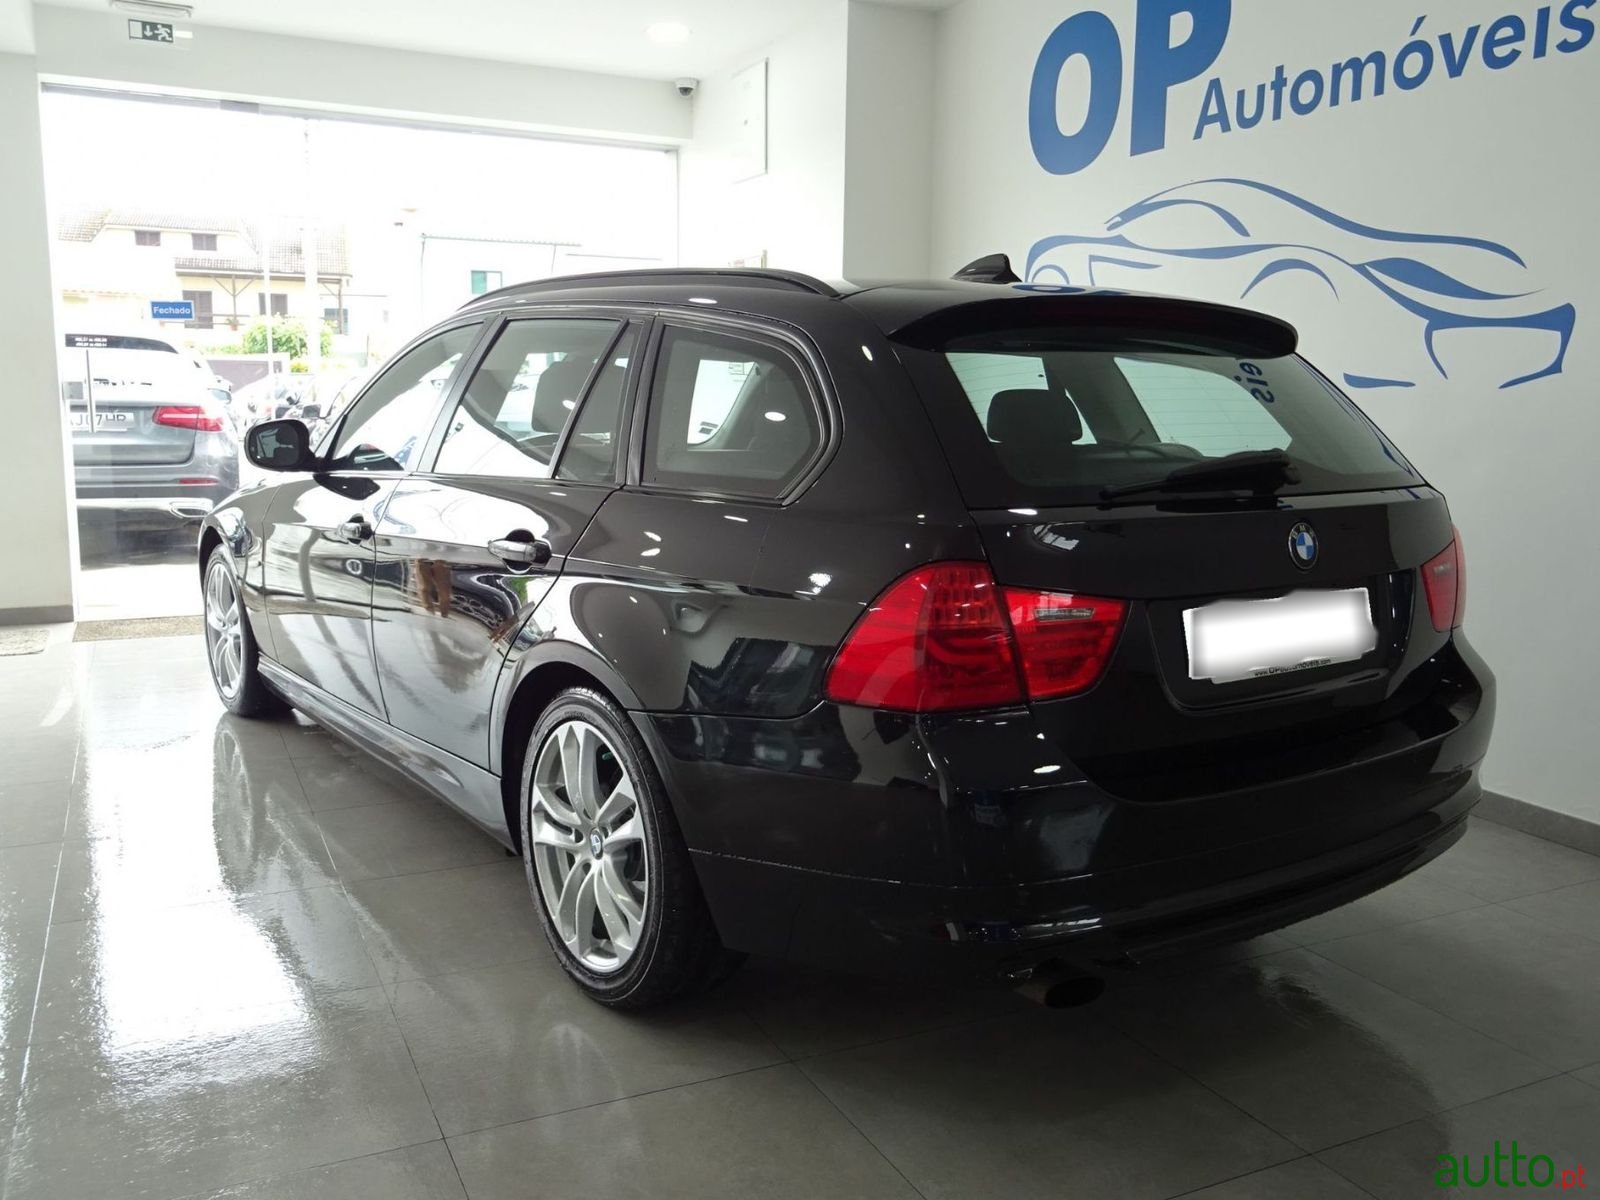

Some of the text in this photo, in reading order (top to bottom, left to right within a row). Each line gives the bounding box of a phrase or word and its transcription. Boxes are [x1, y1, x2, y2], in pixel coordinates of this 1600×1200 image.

[1029, 0, 1598, 175] OP Automóveis
[153, 305, 191, 315] Fechado
